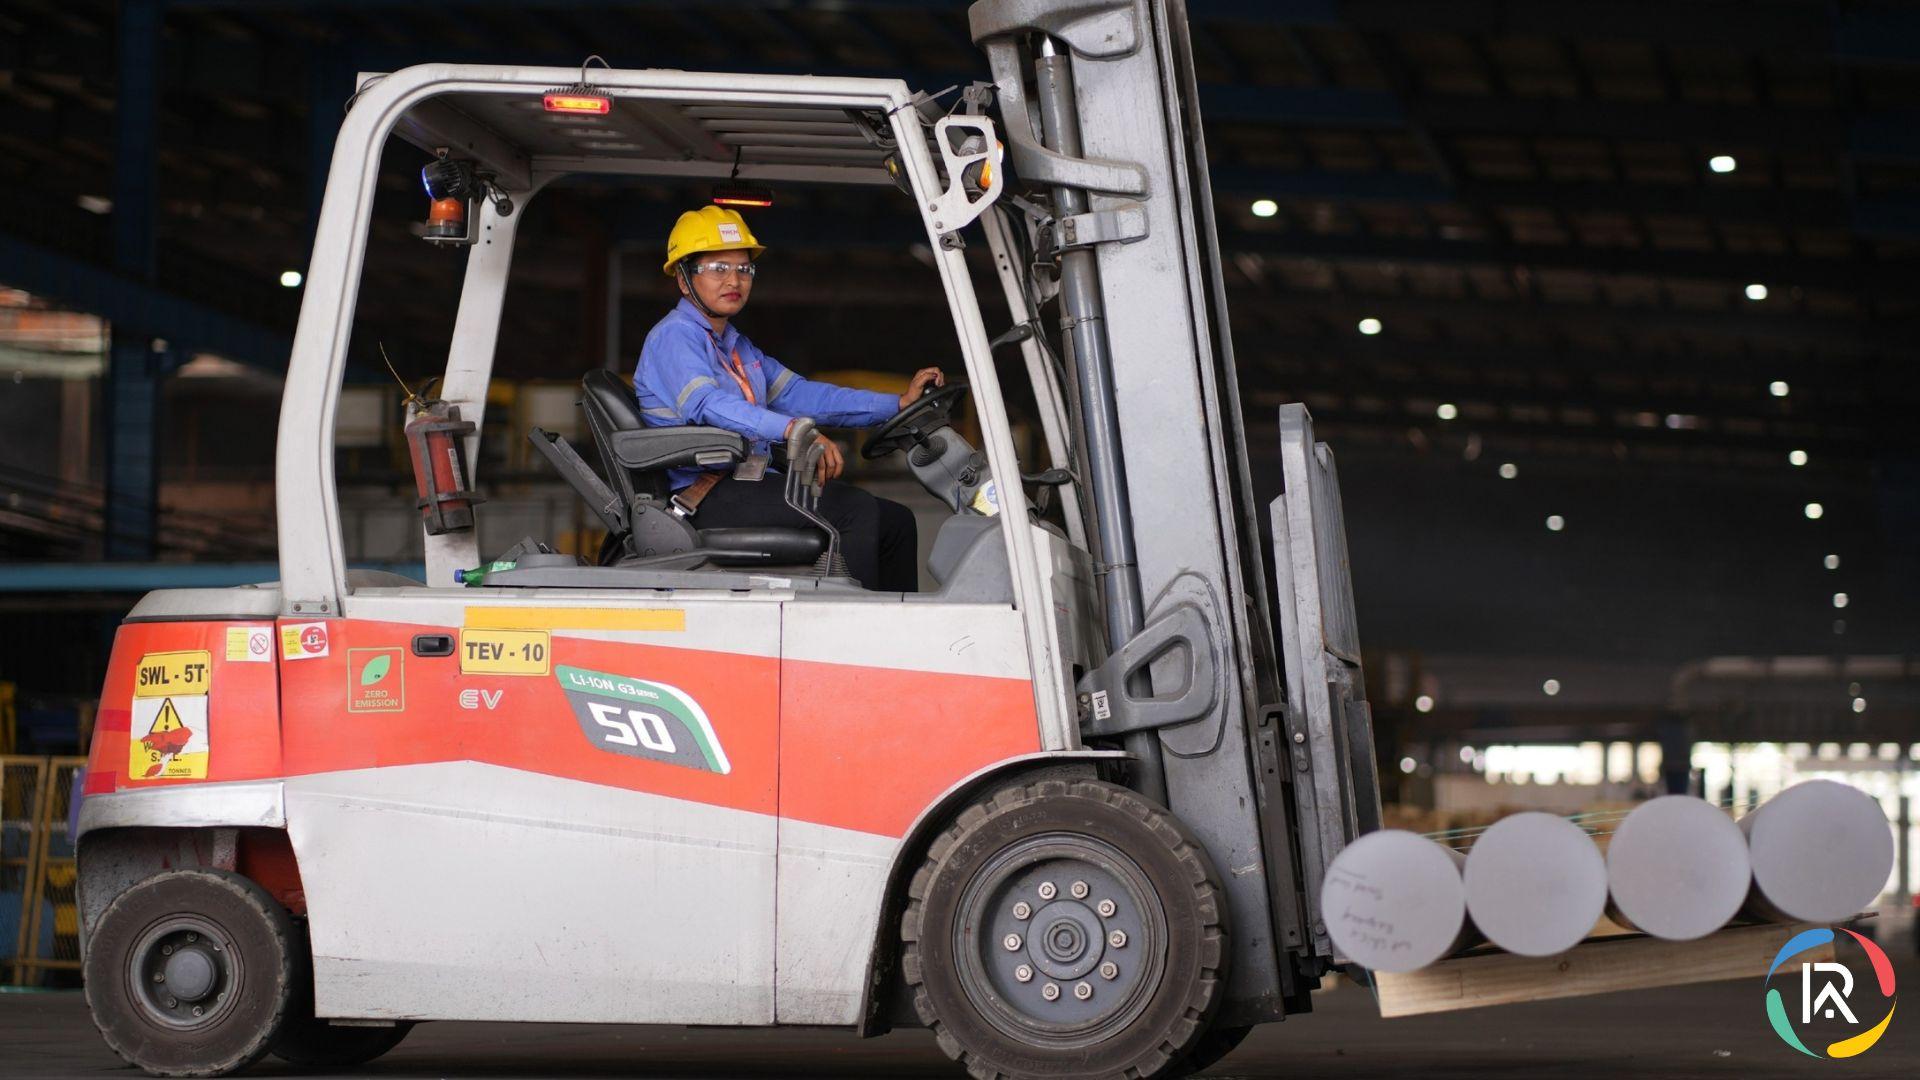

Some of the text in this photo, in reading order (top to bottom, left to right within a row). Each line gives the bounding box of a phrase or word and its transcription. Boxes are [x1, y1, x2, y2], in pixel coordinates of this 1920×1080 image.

[465, 641, 504, 660] TEV
[522, 643, 544, 662] 10
[140, 665, 170, 686] SWL
[184, 663, 205, 683] 5T
[354, 698, 398, 708] EMISSION
[364, 690, 388, 698] ZERO
[459, 689, 504, 710] EV
[587, 702, 677, 753] 50
